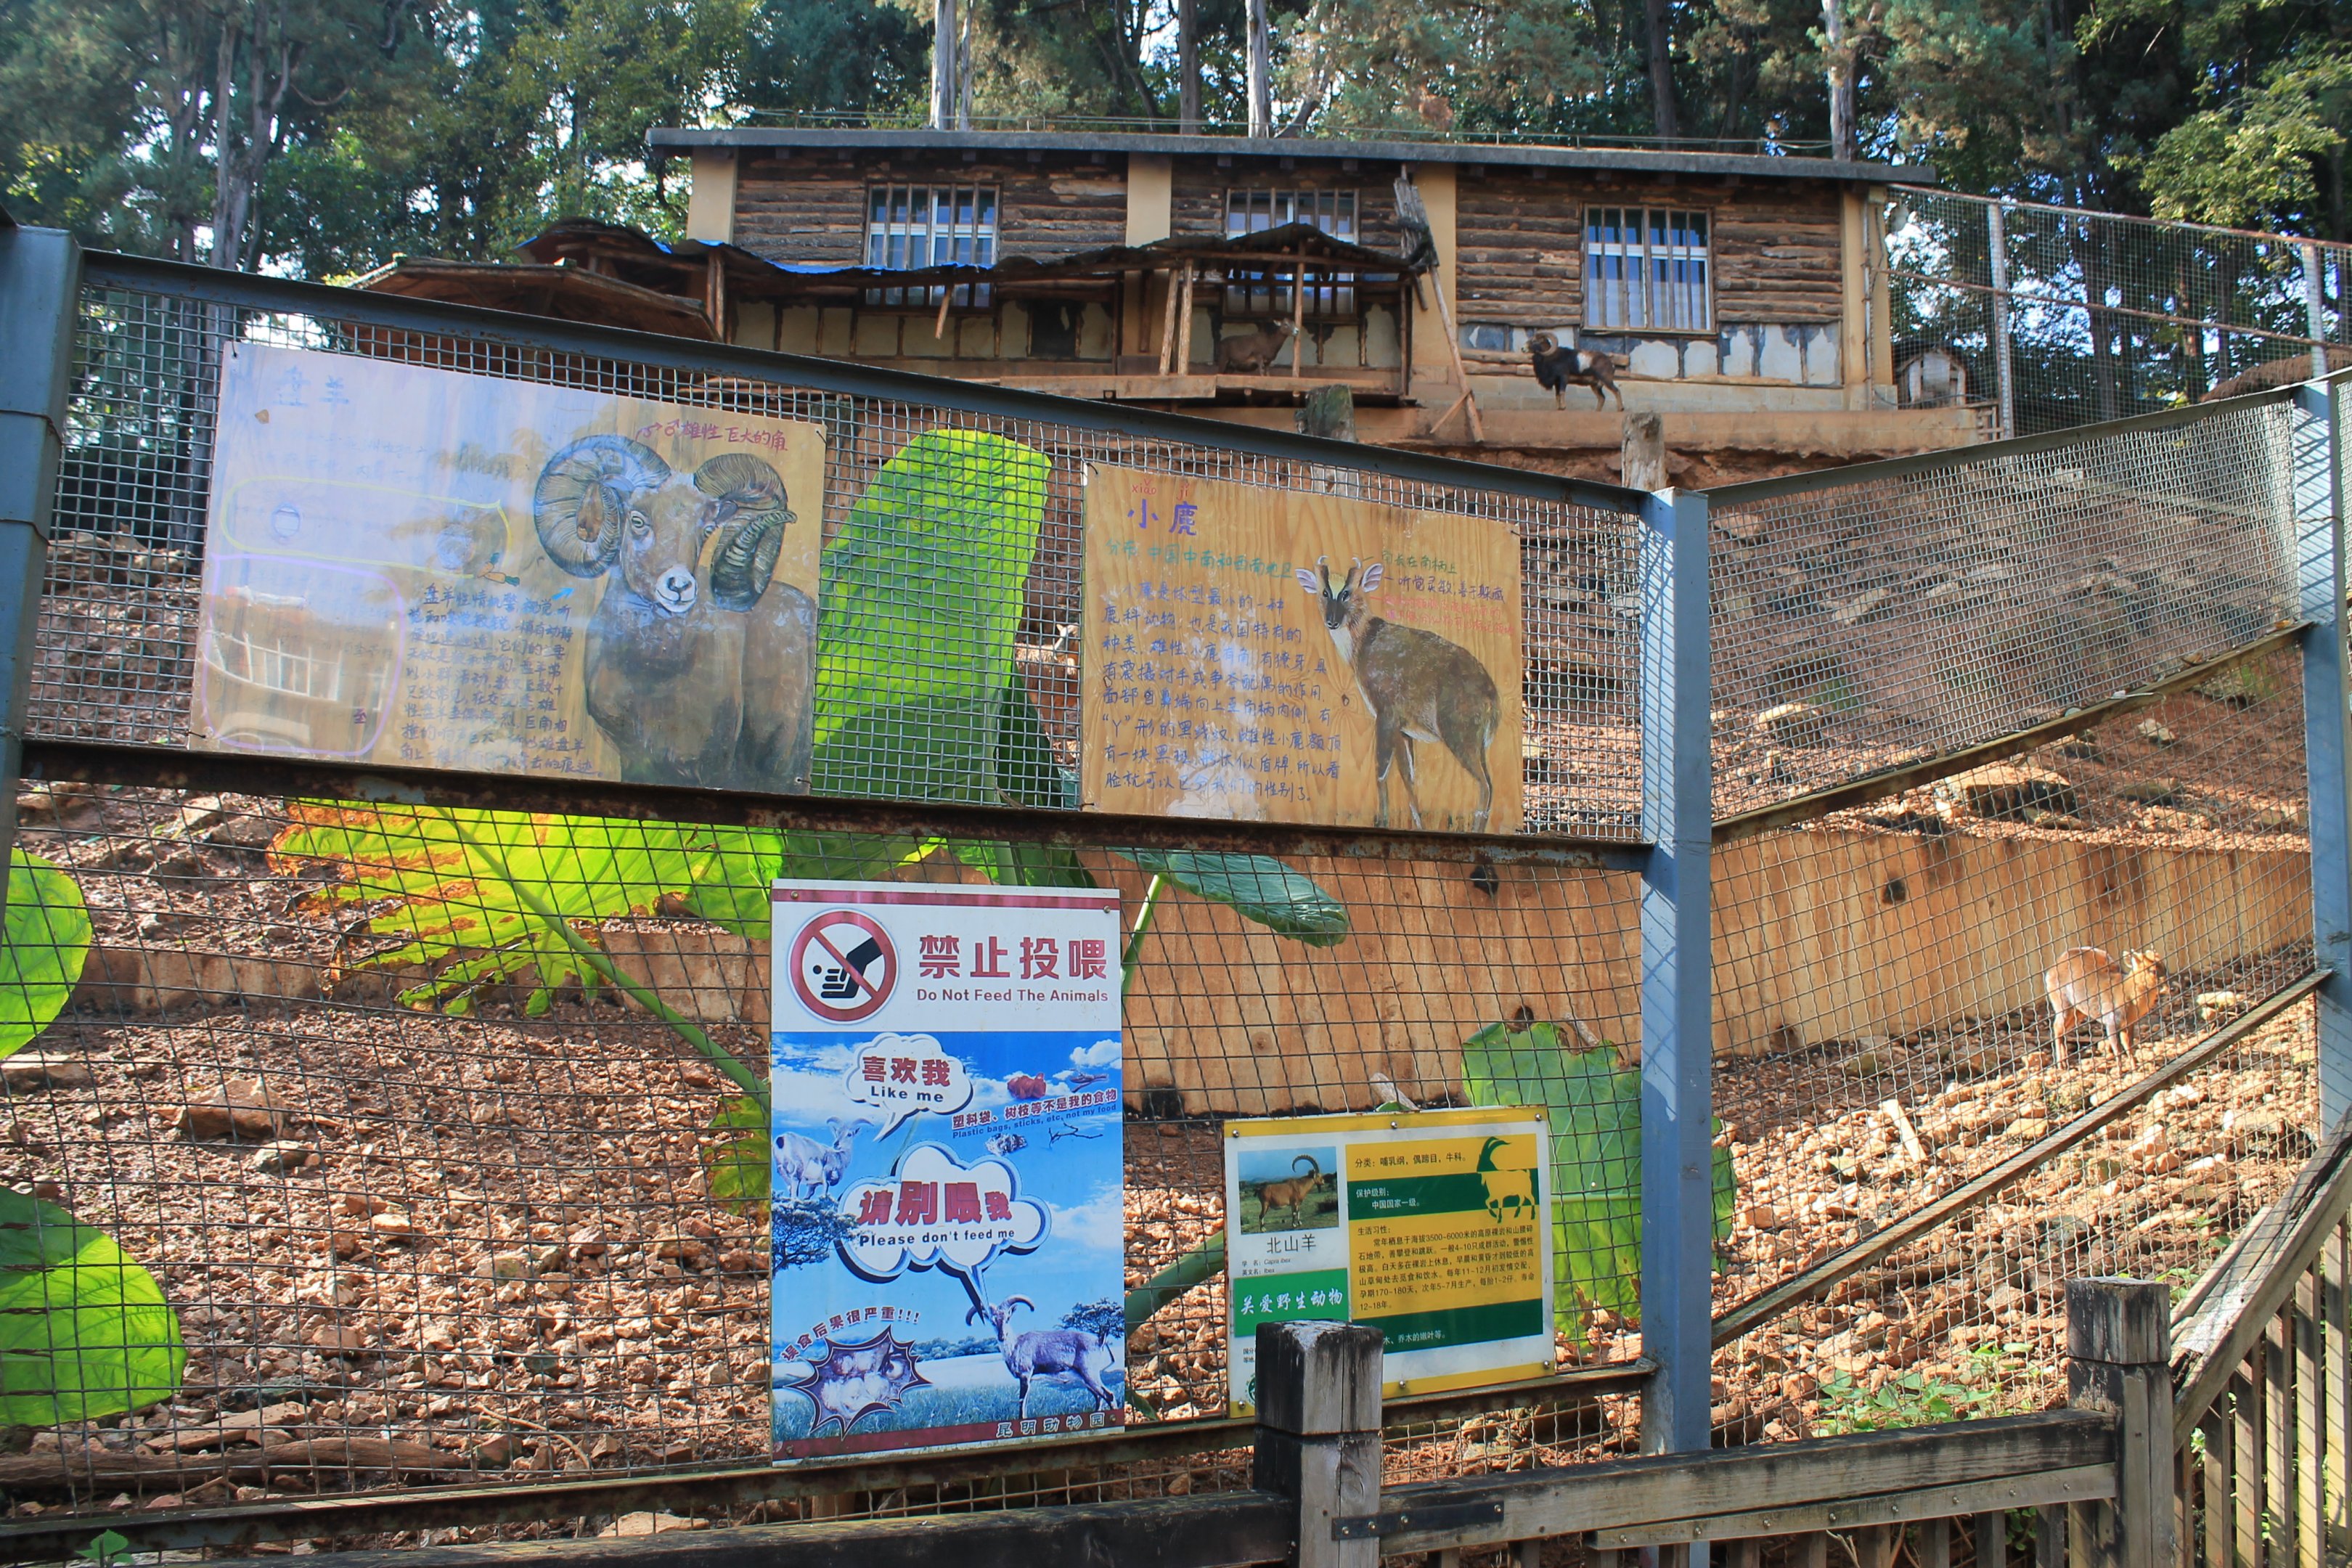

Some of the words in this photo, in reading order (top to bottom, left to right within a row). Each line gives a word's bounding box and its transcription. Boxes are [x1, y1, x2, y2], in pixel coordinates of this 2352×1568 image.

[682, 420, 723, 441] 雄性
[725, 427, 788, 454] 巨大的角
[918, 935, 1108, 980] 禁止投喂
[917, 988, 937, 1001] Do
[942, 989, 969, 1001] Not
[974, 988, 1012, 1002] Feed
[1018, 989, 1045, 1002] The
[1050, 988, 1108, 1003] Animals
[862, 1056, 952, 1087] 喜欢我
[870, 1085, 907, 1100] Like
[917, 1090, 944, 1103] me
[952, 1127, 984, 1139] Plastic
[987, 1123, 1011, 1134] bags,
[1013, 1117, 1044, 1129] sticks,
[1066, 1111, 1080, 1119] not
[1082, 1108, 1095, 1119] my
[1097, 1103, 1116, 1113] food
[857, 1181, 1013, 1225] 请别喂我
[859, 1232, 915, 1246] Please
[922, 1230, 959, 1244] don't
[964, 1228, 993, 1241] feed
[997, 1230, 1015, 1239] me
[1267, 1233, 1317, 1254] 北山羊
[1241, 1288, 1343, 1315] 关爱野生动物
[996, 1412, 1105, 1438] 昆明动物园
